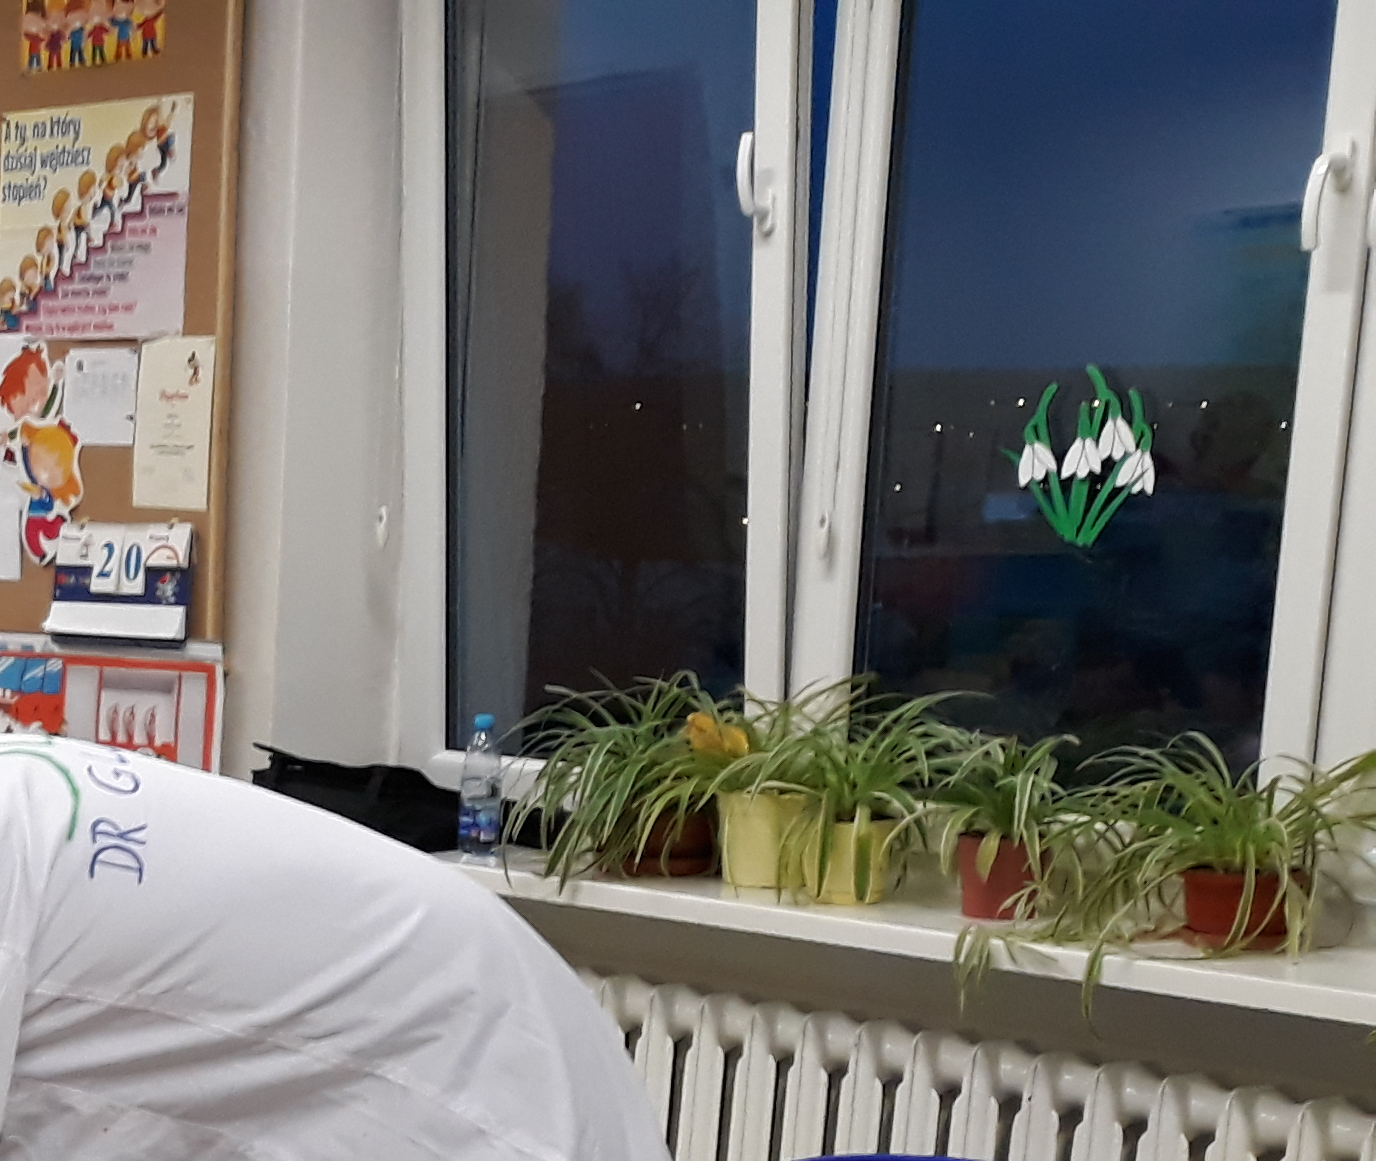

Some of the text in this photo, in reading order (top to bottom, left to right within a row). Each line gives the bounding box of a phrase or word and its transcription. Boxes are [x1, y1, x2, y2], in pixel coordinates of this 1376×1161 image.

[4, 119, 12, 144] A
[32, 120, 47, 138] na
[49, 110, 81, 148] który
[3, 143, 91, 176] dzisiaj wejdziesz
[96, 540, 143, 581] 20
[86, 753, 142, 795] G
